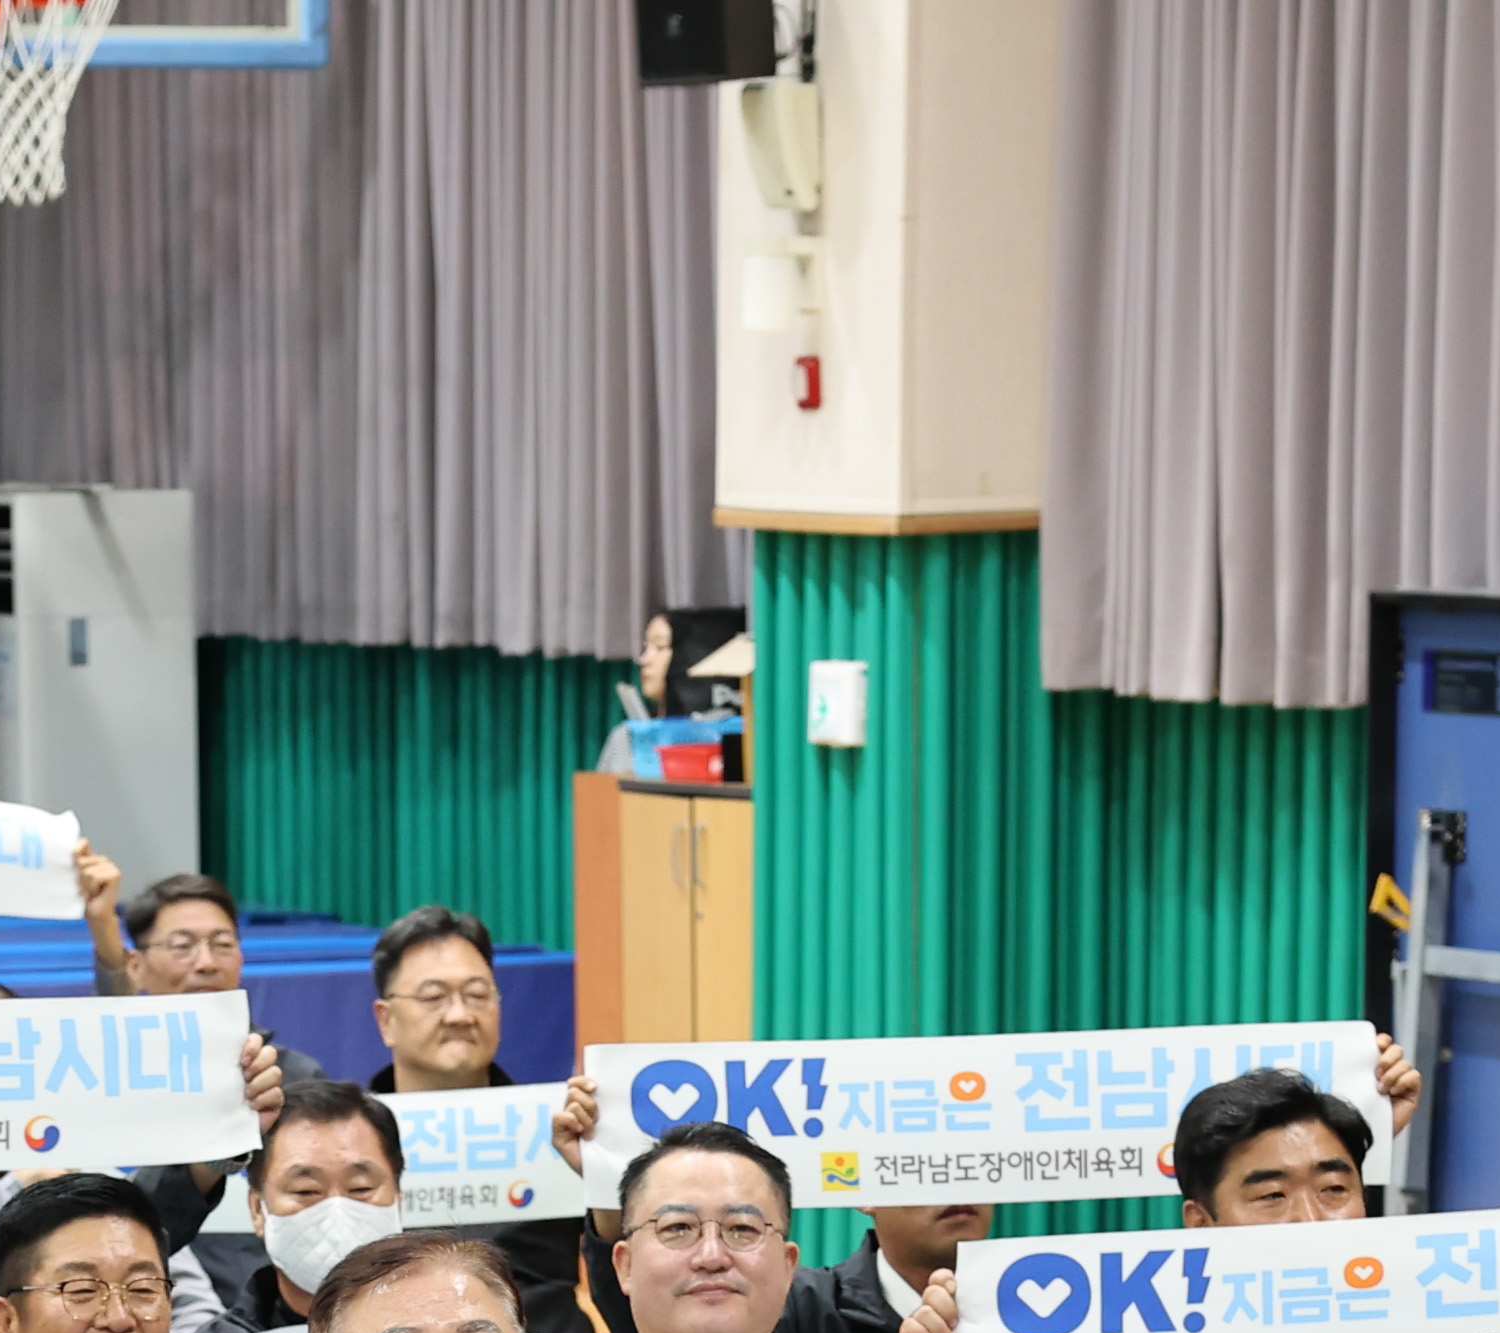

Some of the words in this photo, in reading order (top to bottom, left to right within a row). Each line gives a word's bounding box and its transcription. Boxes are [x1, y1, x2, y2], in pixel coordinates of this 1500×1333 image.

[630, 1058, 826, 1140] OK!
[838, 1070, 993, 1134] 지금은
[873, 1146, 1145, 1187] 전라남도장애인체육회
[1222, 1256, 1390, 1325] 지금은
